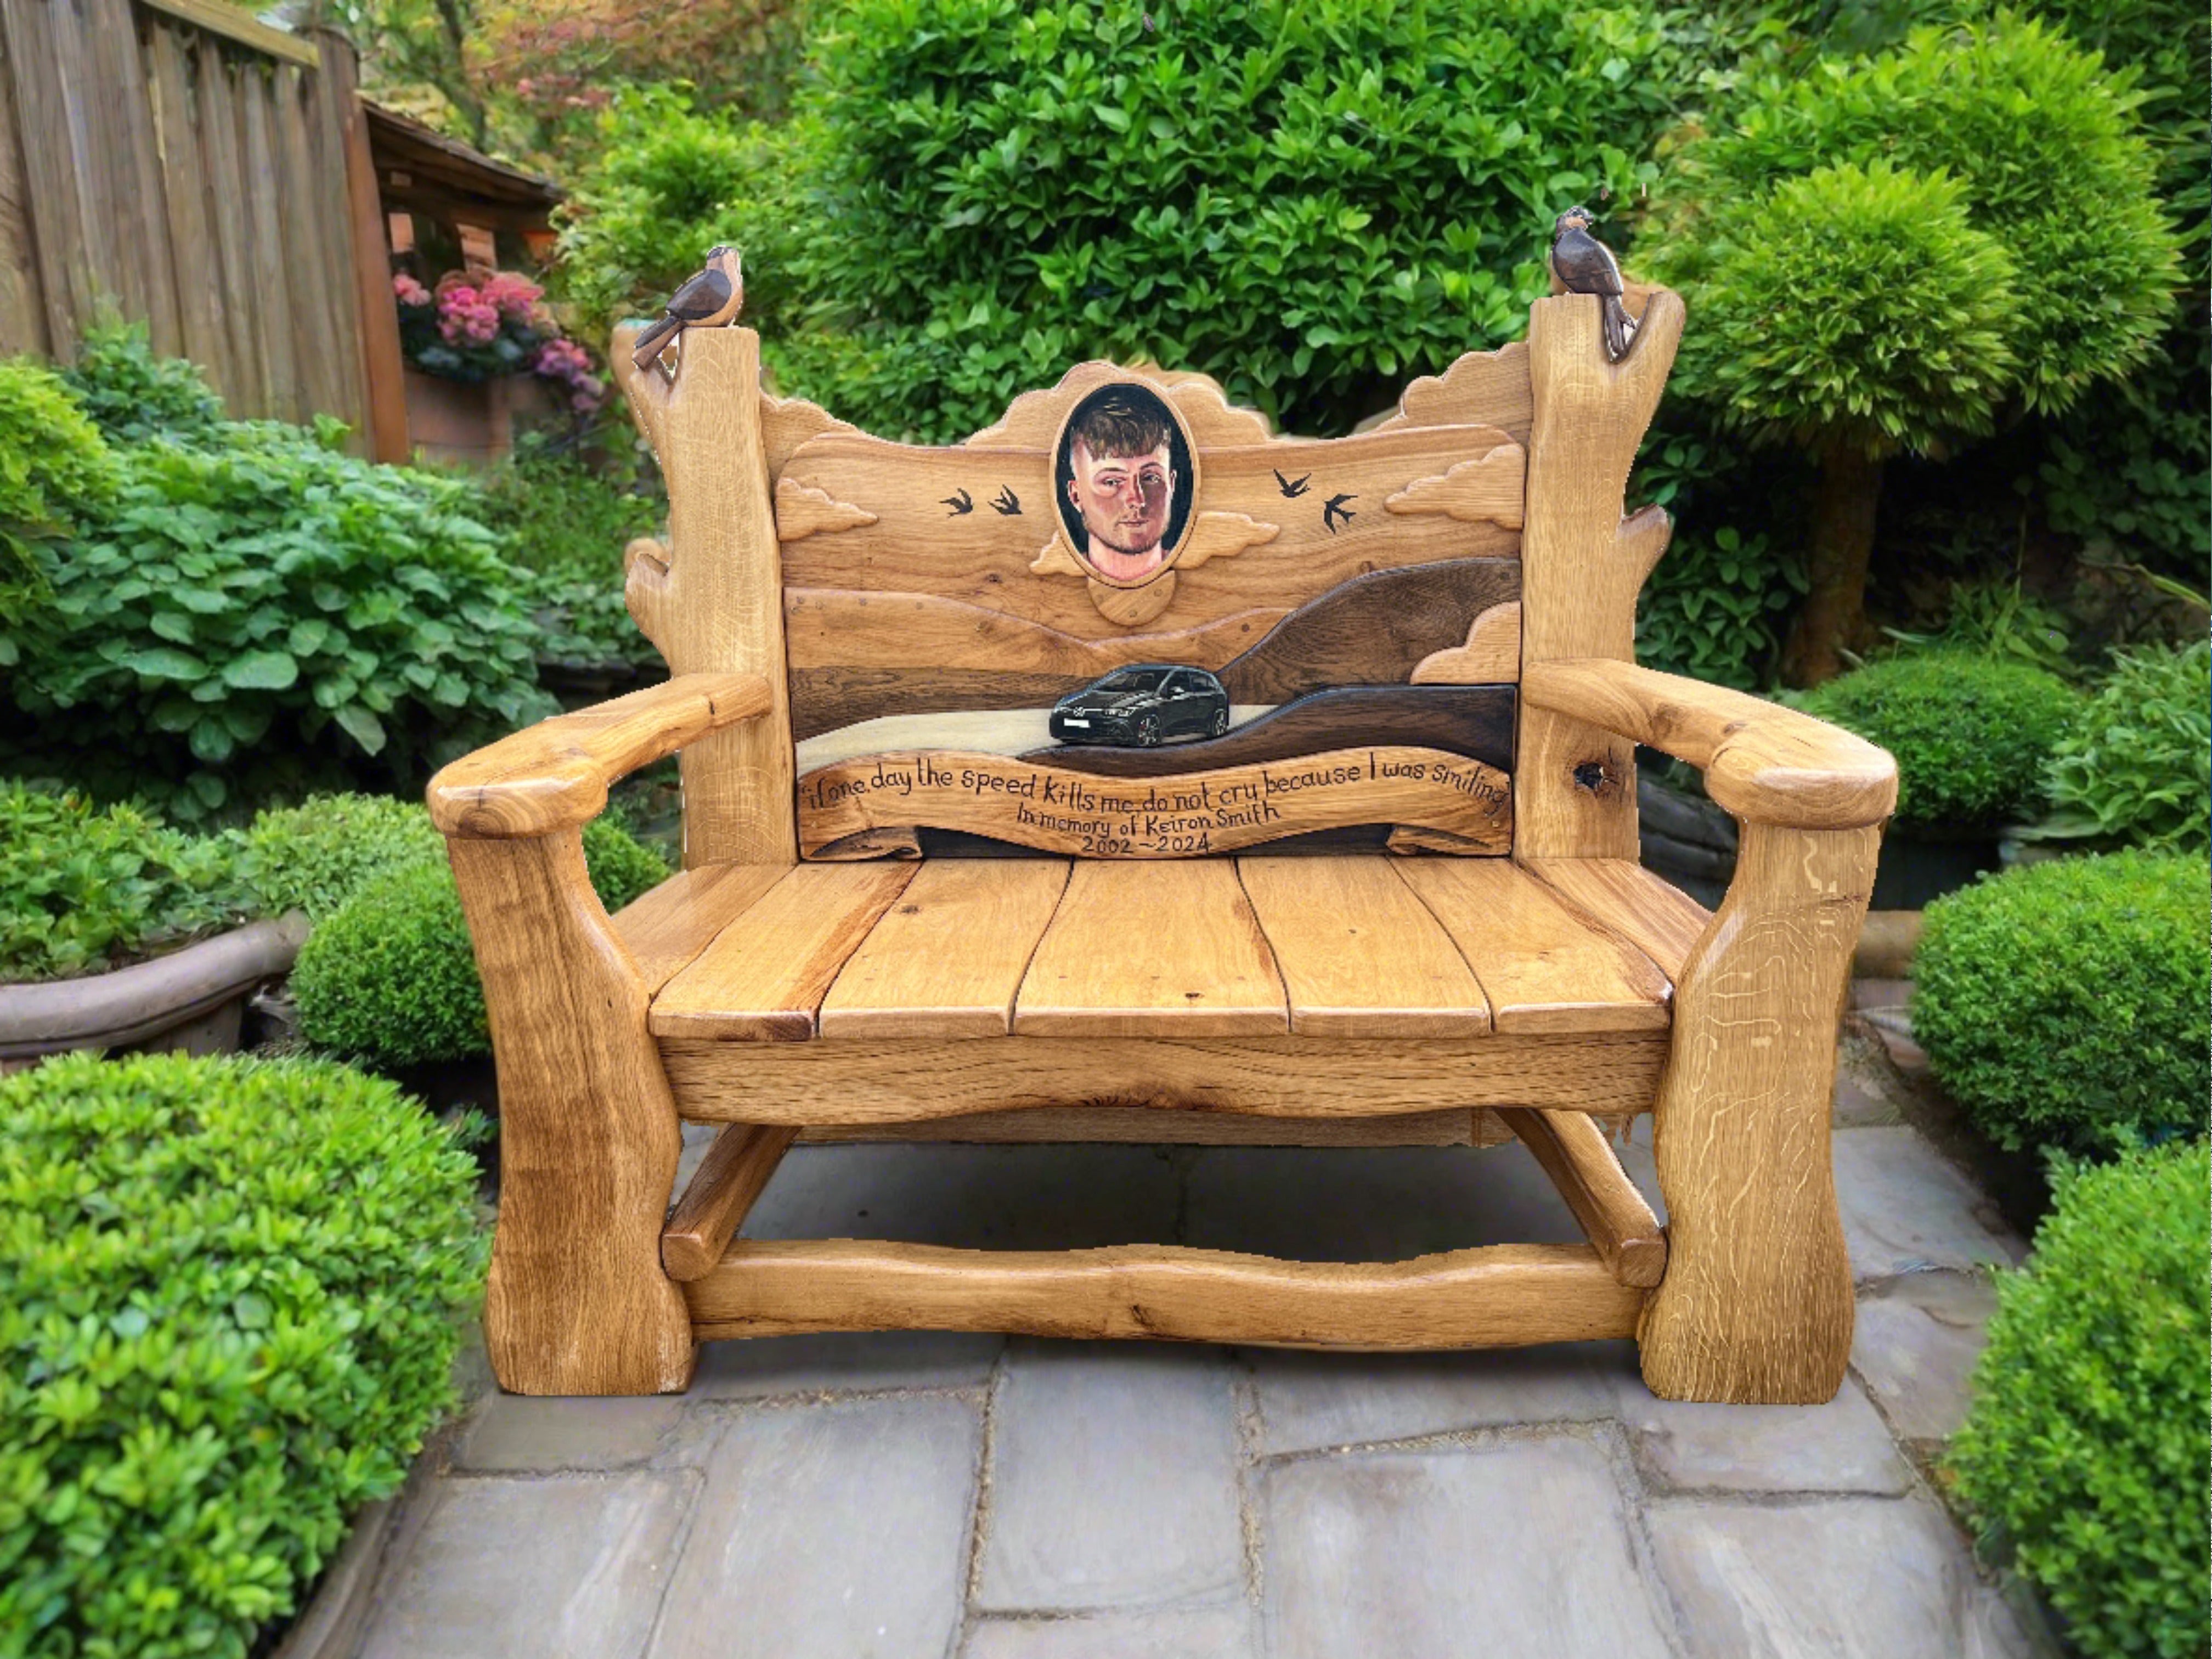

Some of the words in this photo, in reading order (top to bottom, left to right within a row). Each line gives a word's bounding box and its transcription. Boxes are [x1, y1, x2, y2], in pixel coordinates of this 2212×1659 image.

[871, 763, 912, 795] day
[917, 757, 953, 787] the
[961, 770, 1036, 799] speed
[1142, 788, 1168, 811] do
[1173, 781, 1214, 812] not
[1219, 783, 1257, 805] cry
[1262, 766, 1361, 797] because
[1370, 752, 1375, 780] I
[1383, 763, 1426, 779] was
[1039, 811, 1110, 838] memory
[1119, 815, 1137, 836] of
[1146, 814, 1214, 836] Keiron
[1216, 800, 1280, 827] Smith
